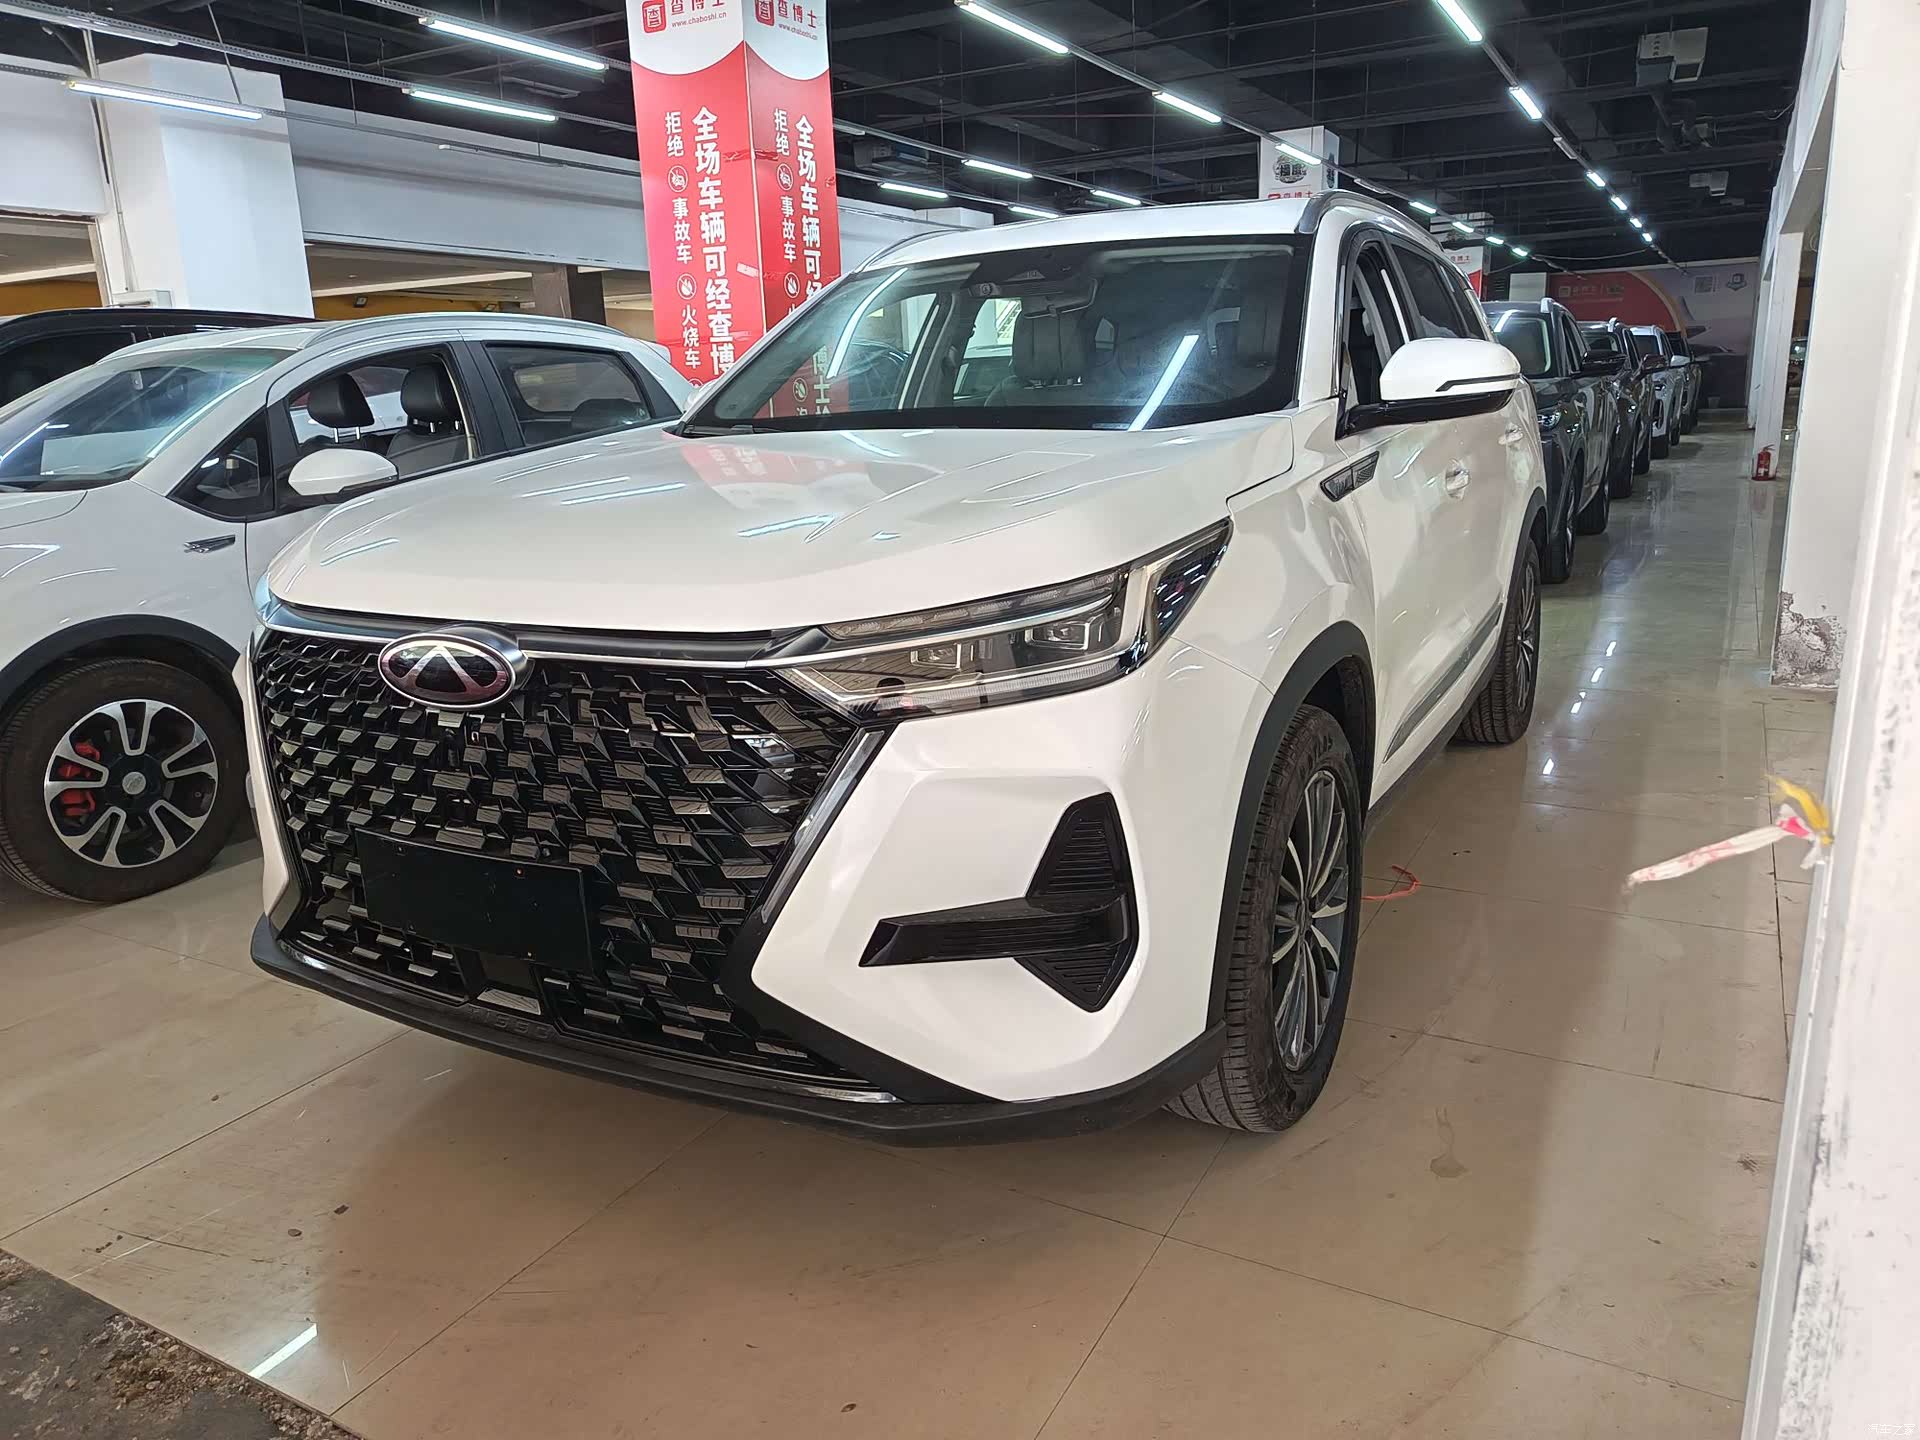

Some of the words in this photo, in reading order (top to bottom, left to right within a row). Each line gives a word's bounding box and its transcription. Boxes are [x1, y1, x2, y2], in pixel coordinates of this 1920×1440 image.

[672, 12, 727, 27] www.chaboshi.cn
[664, 111, 684, 157] 拒绝
[773, 108, 790, 156] 拒绝
[672, 197, 693, 264] 事故车
[780, 196, 797, 263] 事故车
[681, 305, 701, 369] 火烧车
